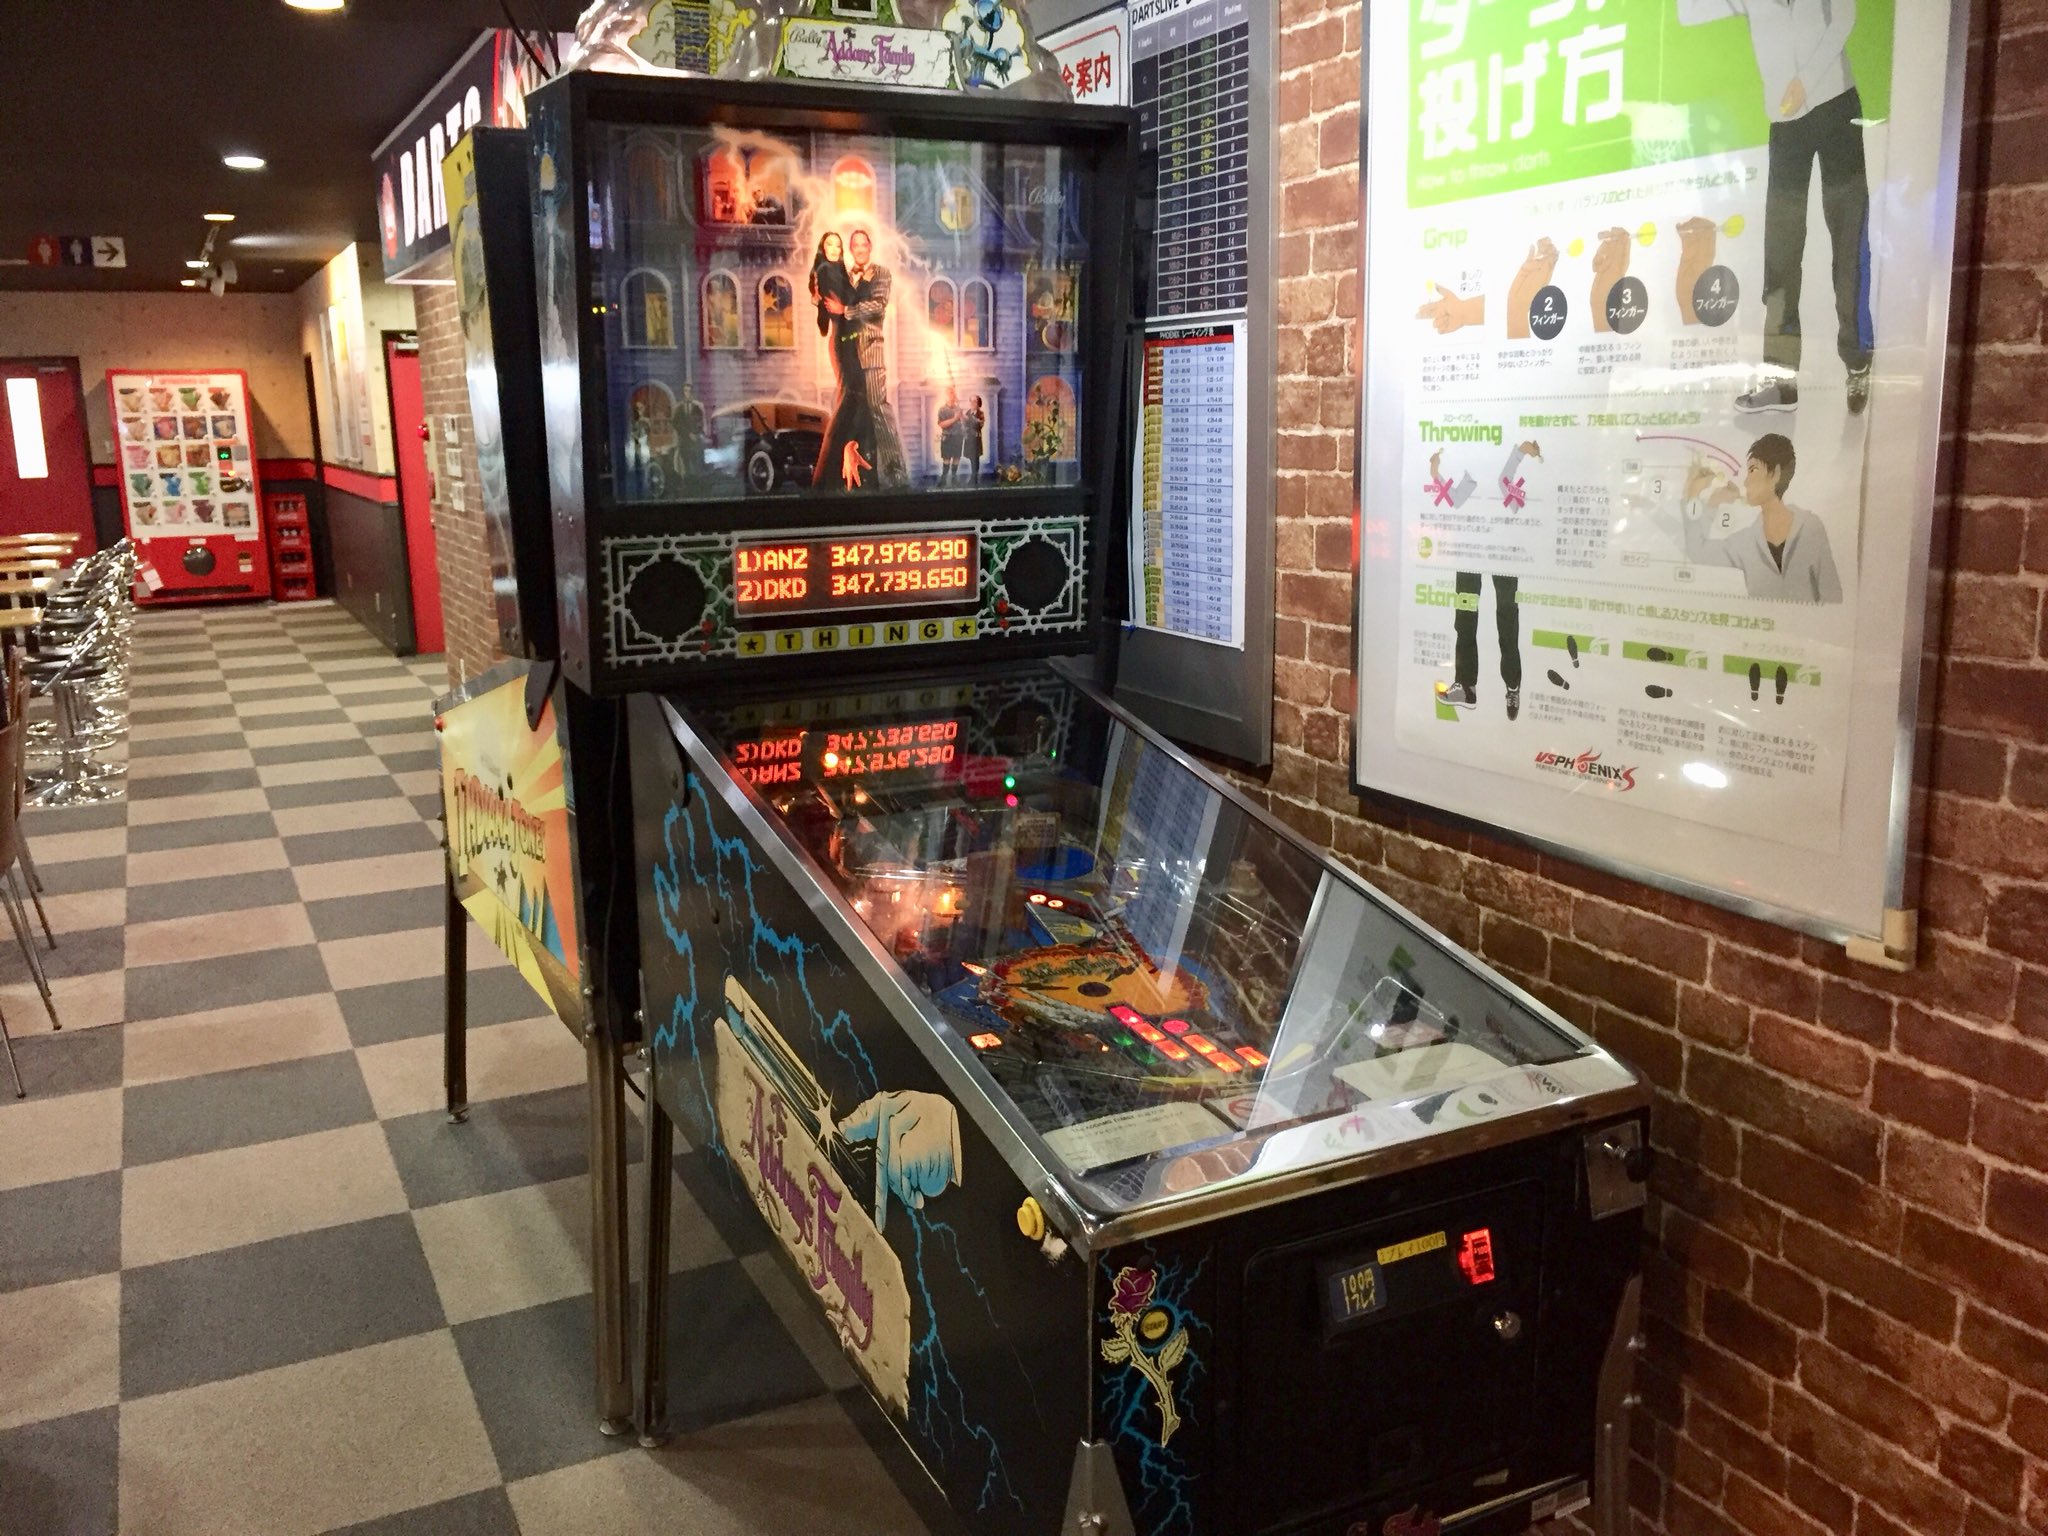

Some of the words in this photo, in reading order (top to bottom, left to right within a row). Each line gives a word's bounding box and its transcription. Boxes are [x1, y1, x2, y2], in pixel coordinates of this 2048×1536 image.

[1132, 0, 1179, 25] DARTSLIVE
[818, 29, 876, 74] Addams
[871, 33, 915, 84] Family
[1418, 24, 1627, 160] 投げ方
[1450, 167, 1466, 184] to
[1512, 151, 1551, 173] darts
[1228, 174, 1236, 184] 10
[1228, 190, 1235, 199] 11
[1228, 206, 1236, 215] 12
[1229, 222, 1236, 231] 13
[1228, 237, 1235, 246] 14
[1423, 228, 1468, 250] Grip
[1228, 253, 1235, 262] 15
[1228, 268, 1236, 277] 16
[1228, 283, 1235, 292] 17
[1710, 278, 1721, 294] 4
[1622, 288, 1632, 304] 3
[1228, 299, 1236, 308] 18
[1544, 297, 1553, 312] 2
[1696, 297, 1735, 311] フィンガー
[1531, 313, 1564, 326] フィンガー
[1609, 306, 1645, 319] フィンガー
[1418, 419, 1502, 445] Throwing
[1653, 480, 1662, 494] 3
[1721, 513, 1730, 527] 2
[738, 548, 808, 575] 1)ANZ
[831, 539, 968, 568] 347.976.290
[738, 575, 807, 601] 2)DKD
[831, 567, 968, 598] 347.739.650
[1415, 584, 1477, 611] Stance
[783, 622, 938, 651] THING
[806, 1162, 874, 1352] Family
